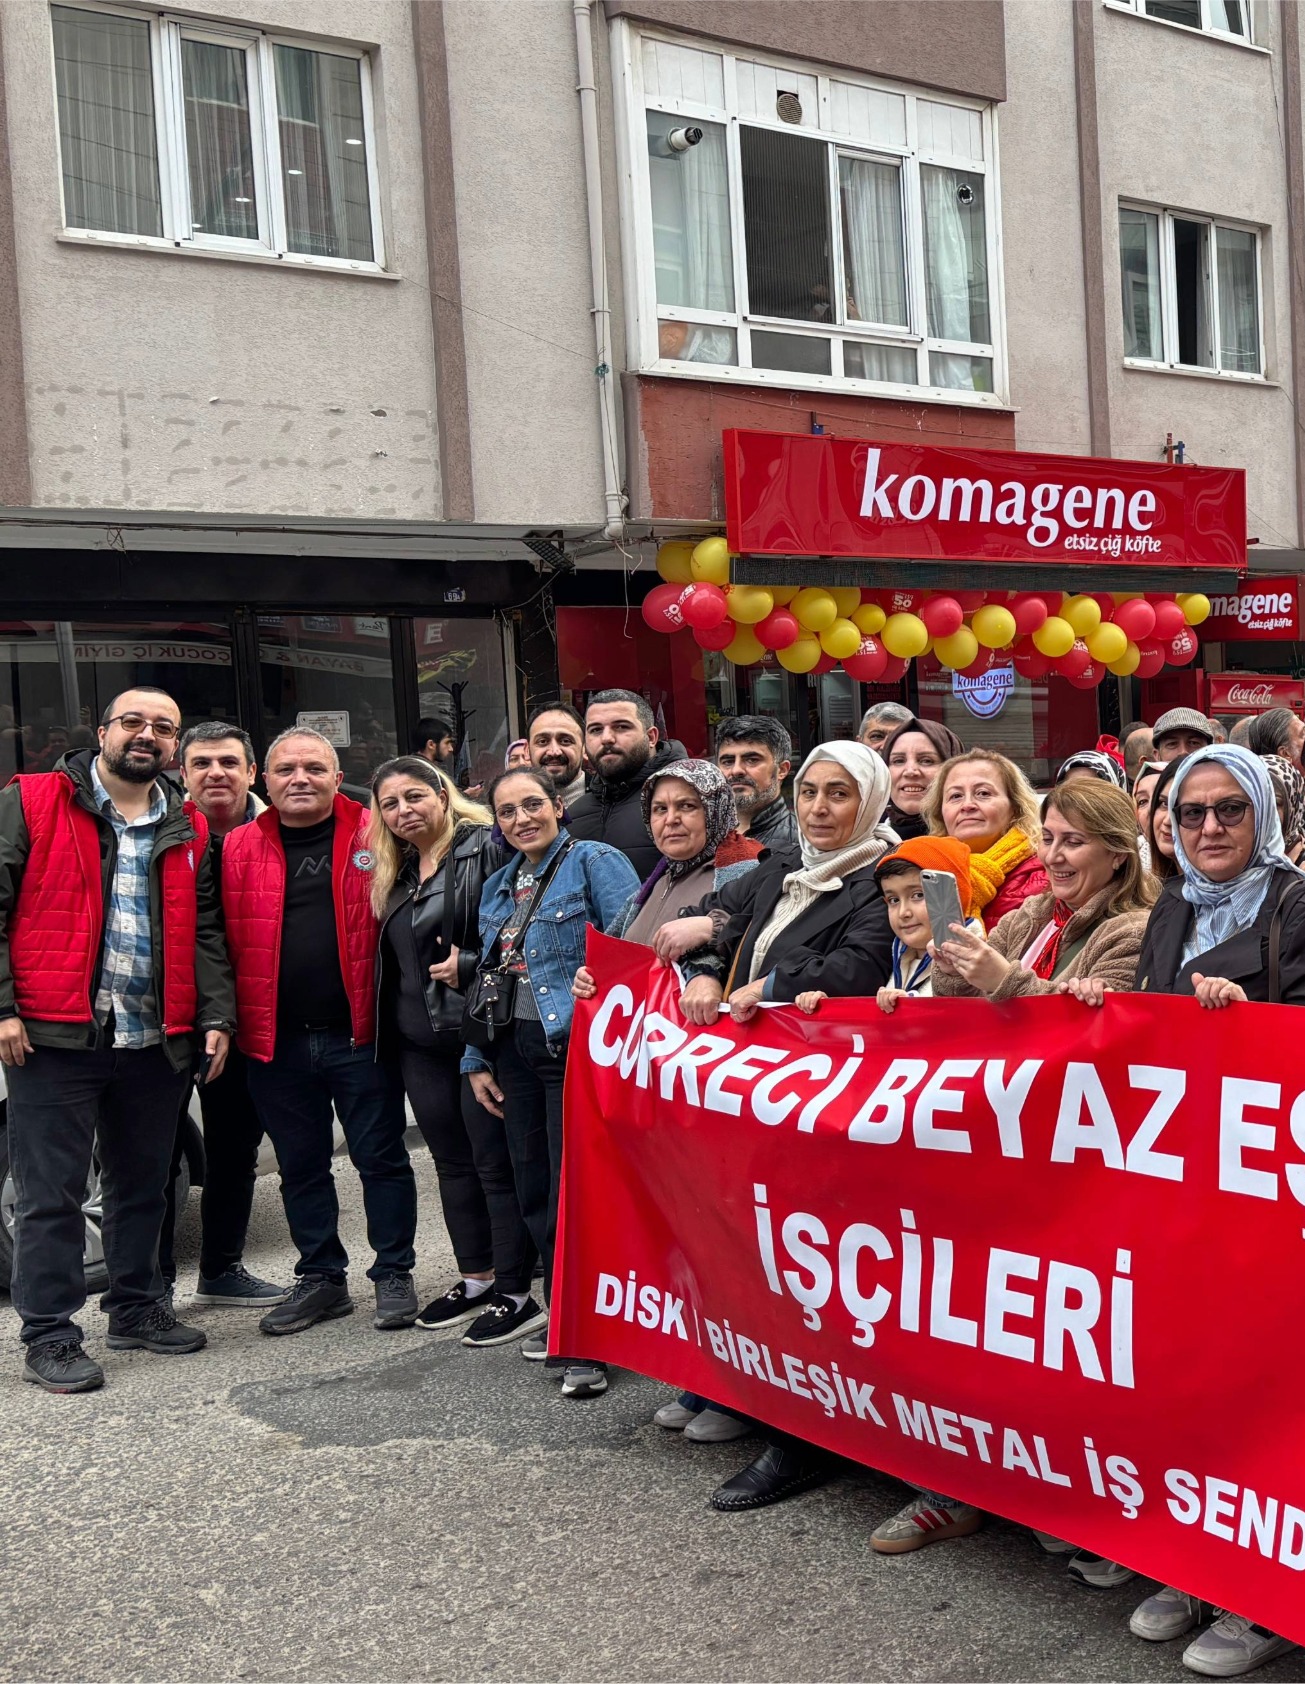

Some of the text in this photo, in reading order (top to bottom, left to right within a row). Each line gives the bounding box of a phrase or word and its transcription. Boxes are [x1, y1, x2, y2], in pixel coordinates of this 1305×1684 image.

[859, 447, 1157, 547] komagene
[1064, 533, 1162, 557] etsiz çiğ köfte
[1208, 592, 1293, 624] magene
[848, 1058, 1187, 1182] BEYAZ
[753, 1183, 1135, 1389] İŞÇİLERİ
[594, 1270, 689, 1341] DİSK
[704, 1318, 889, 1419] BİRLEŞİK
[891, 1392, 1072, 1488] METAL
[1083, 1437, 1145, 1520] İŞ
